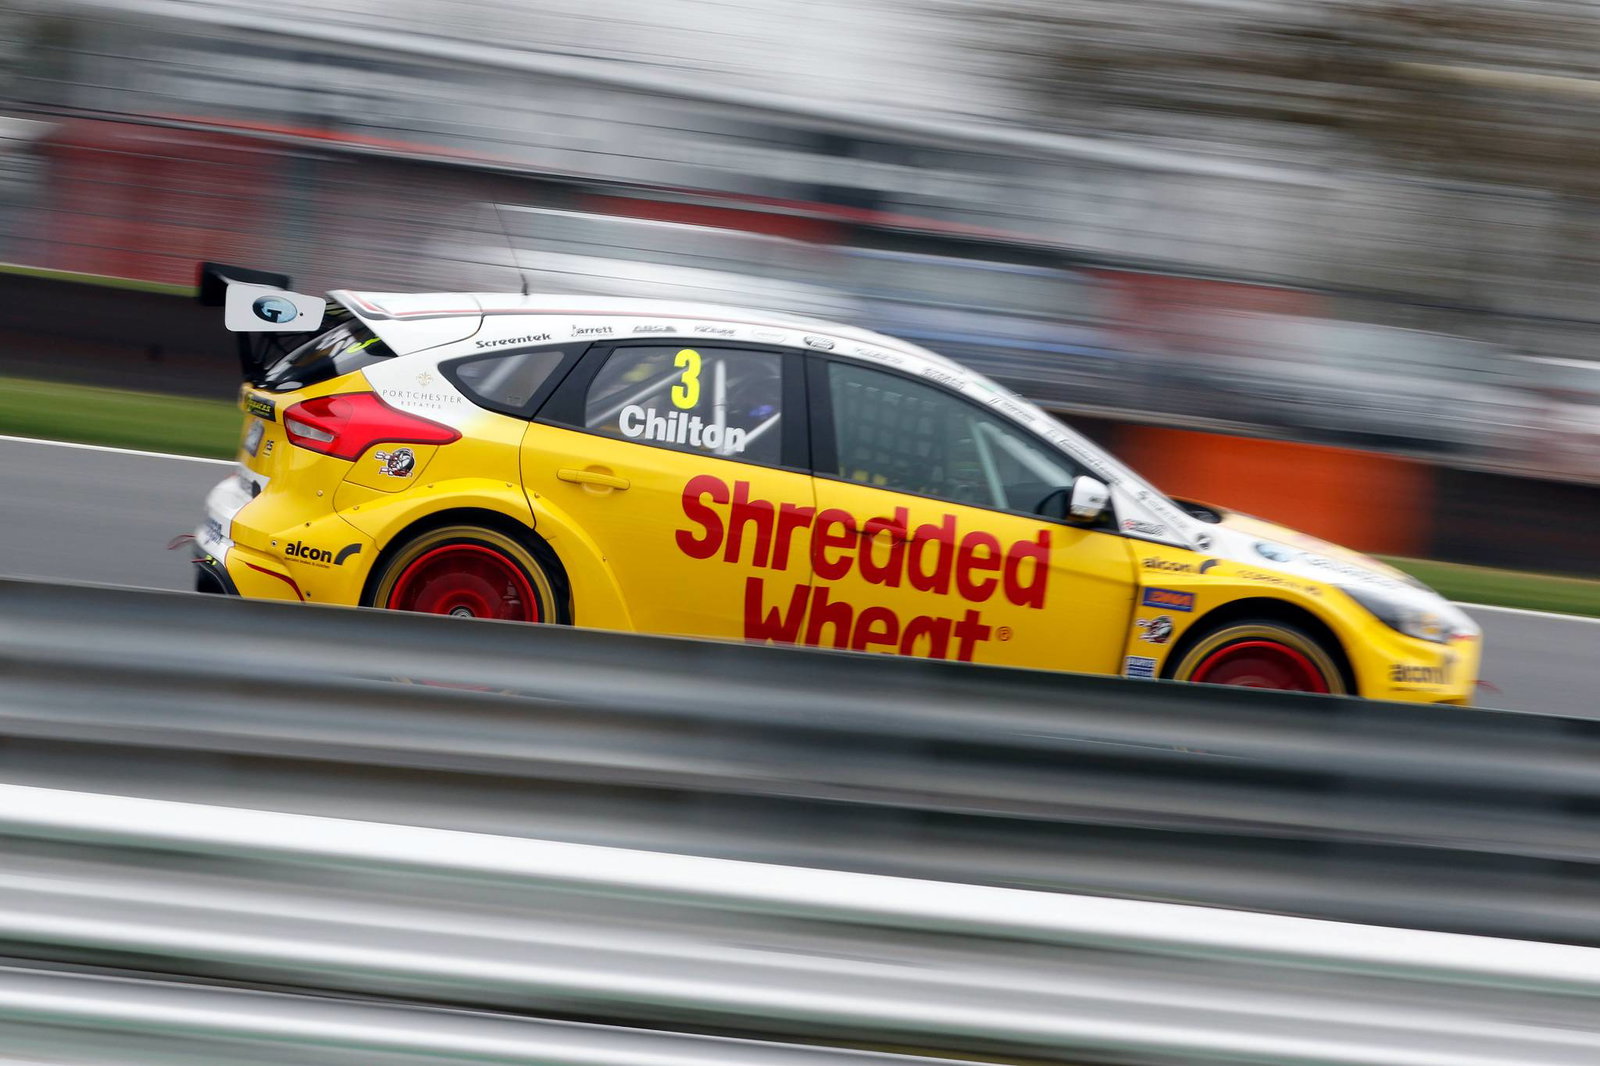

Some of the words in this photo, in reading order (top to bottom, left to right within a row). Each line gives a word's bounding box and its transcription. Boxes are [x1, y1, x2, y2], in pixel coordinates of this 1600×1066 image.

[475, 333, 552, 349] Screentek
[382, 389, 462, 404] PORTCHESTER
[671, 349, 702, 410] 3
[401, 401, 441, 409] ESTATES
[618, 404, 746, 452] Chilton
[285, 541, 332, 563] alcon
[675, 474, 1052, 609] Shredded
[743, 576, 990, 662] Wheat
